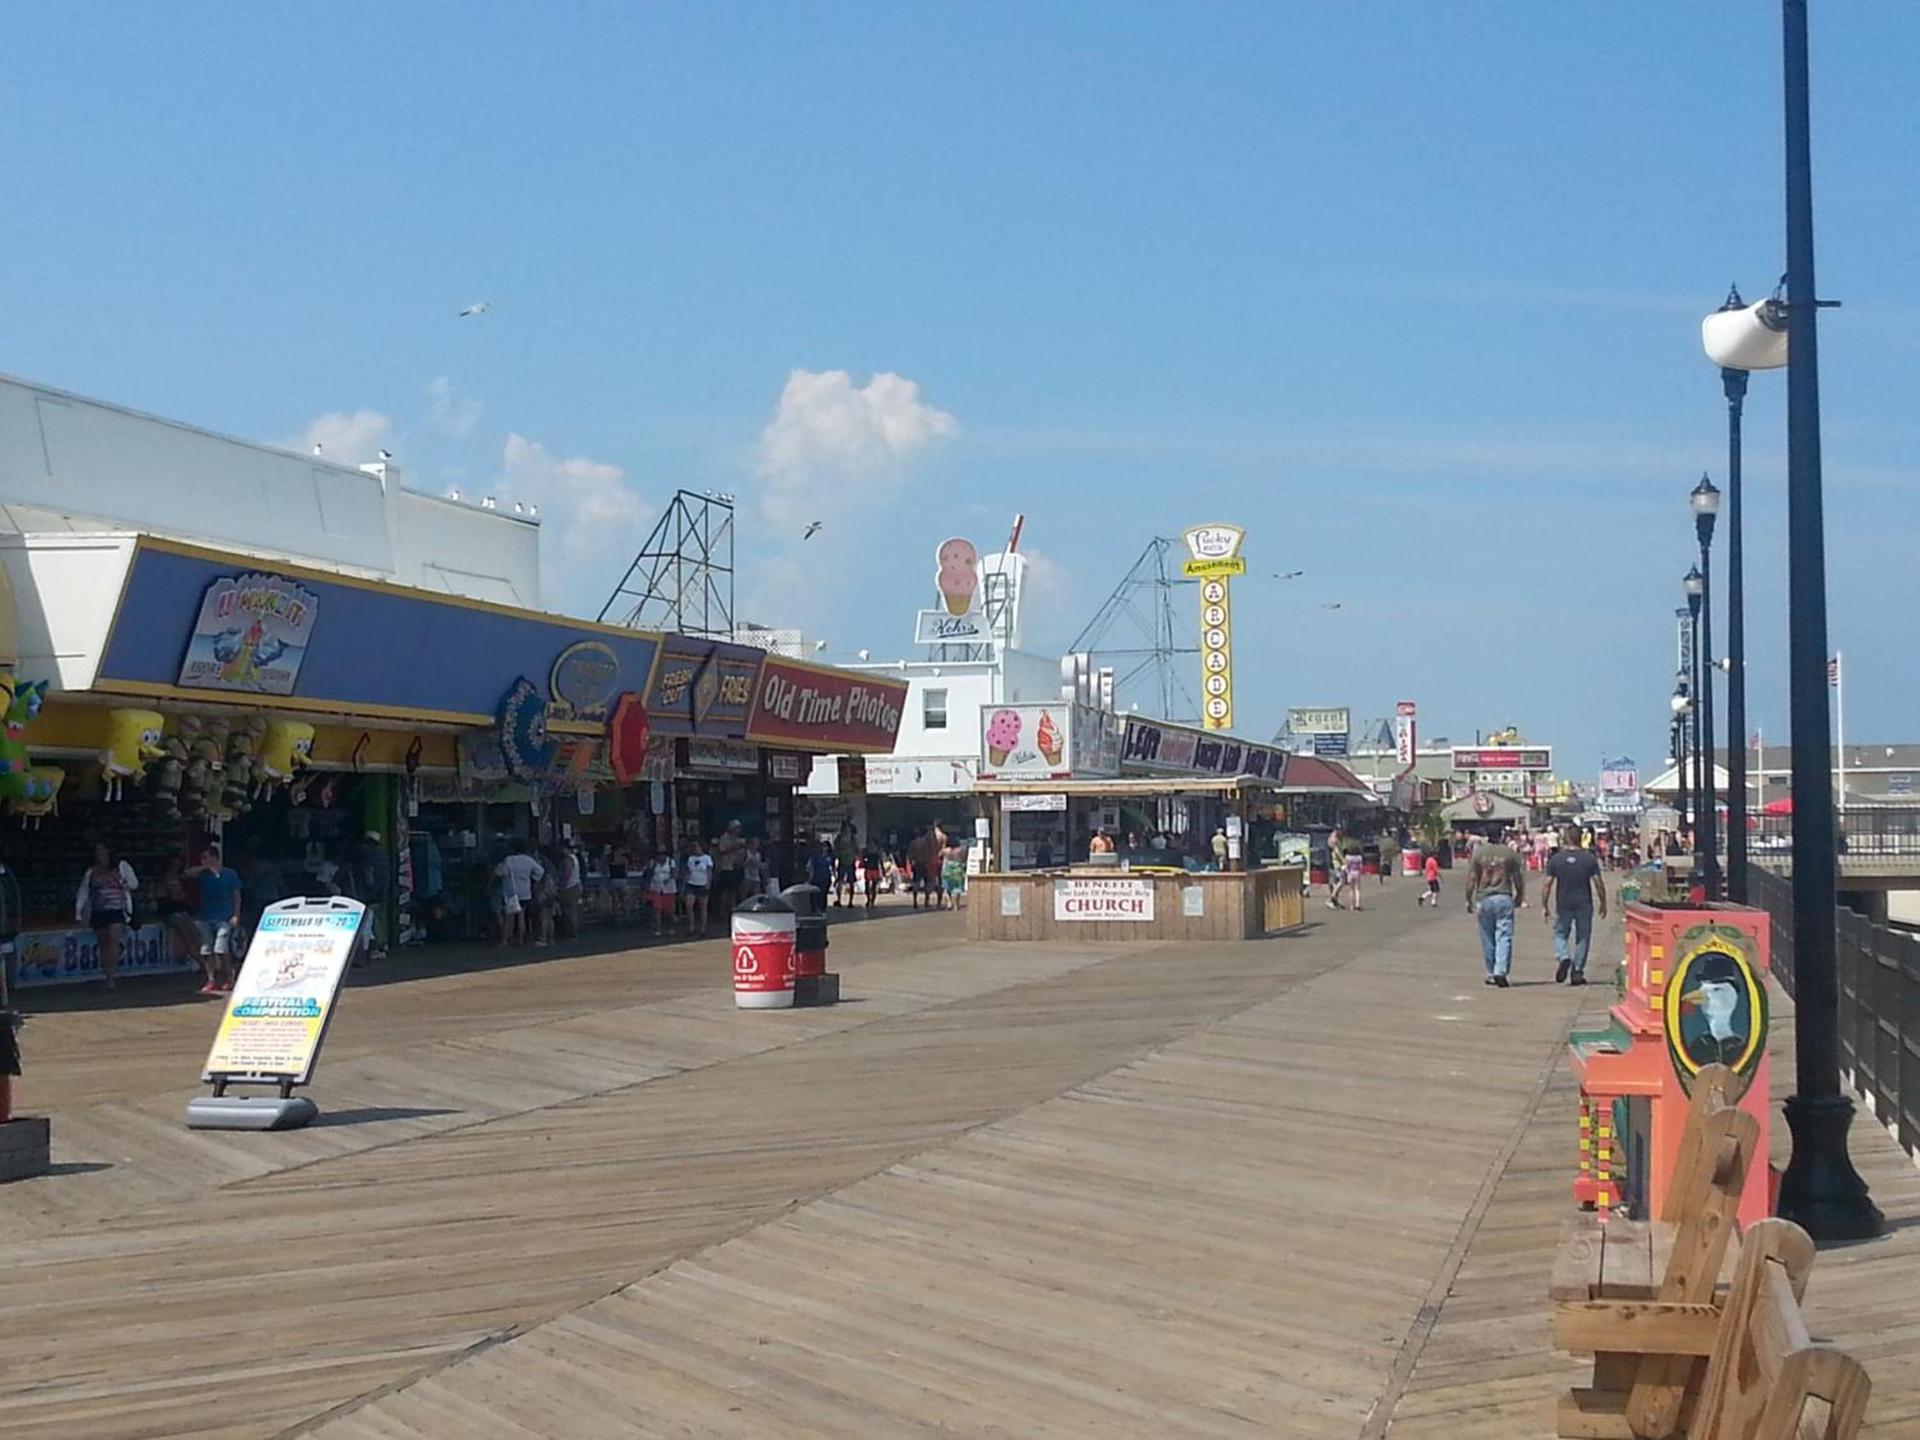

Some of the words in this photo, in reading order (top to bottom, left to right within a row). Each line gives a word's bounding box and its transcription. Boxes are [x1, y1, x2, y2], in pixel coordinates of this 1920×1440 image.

[1186, 560, 1241, 573] Amusement
[1206, 584, 1224, 715] ARCADE
[662, 688, 683, 704] CUT
[720, 675, 751, 704] FRIES
[763, 674, 797, 720] Old
[797, 688, 842, 723] Time
[845, 686, 899, 734] Photos
[1074, 880, 1134, 889] BENEFIT
[1065, 899, 1144, 914] CHURCH
[266, 916, 313, 928] SEPTEMBER
[243, 996, 304, 1007] FESTIVAL
[232, 1006, 321, 1017] COMPETITION
